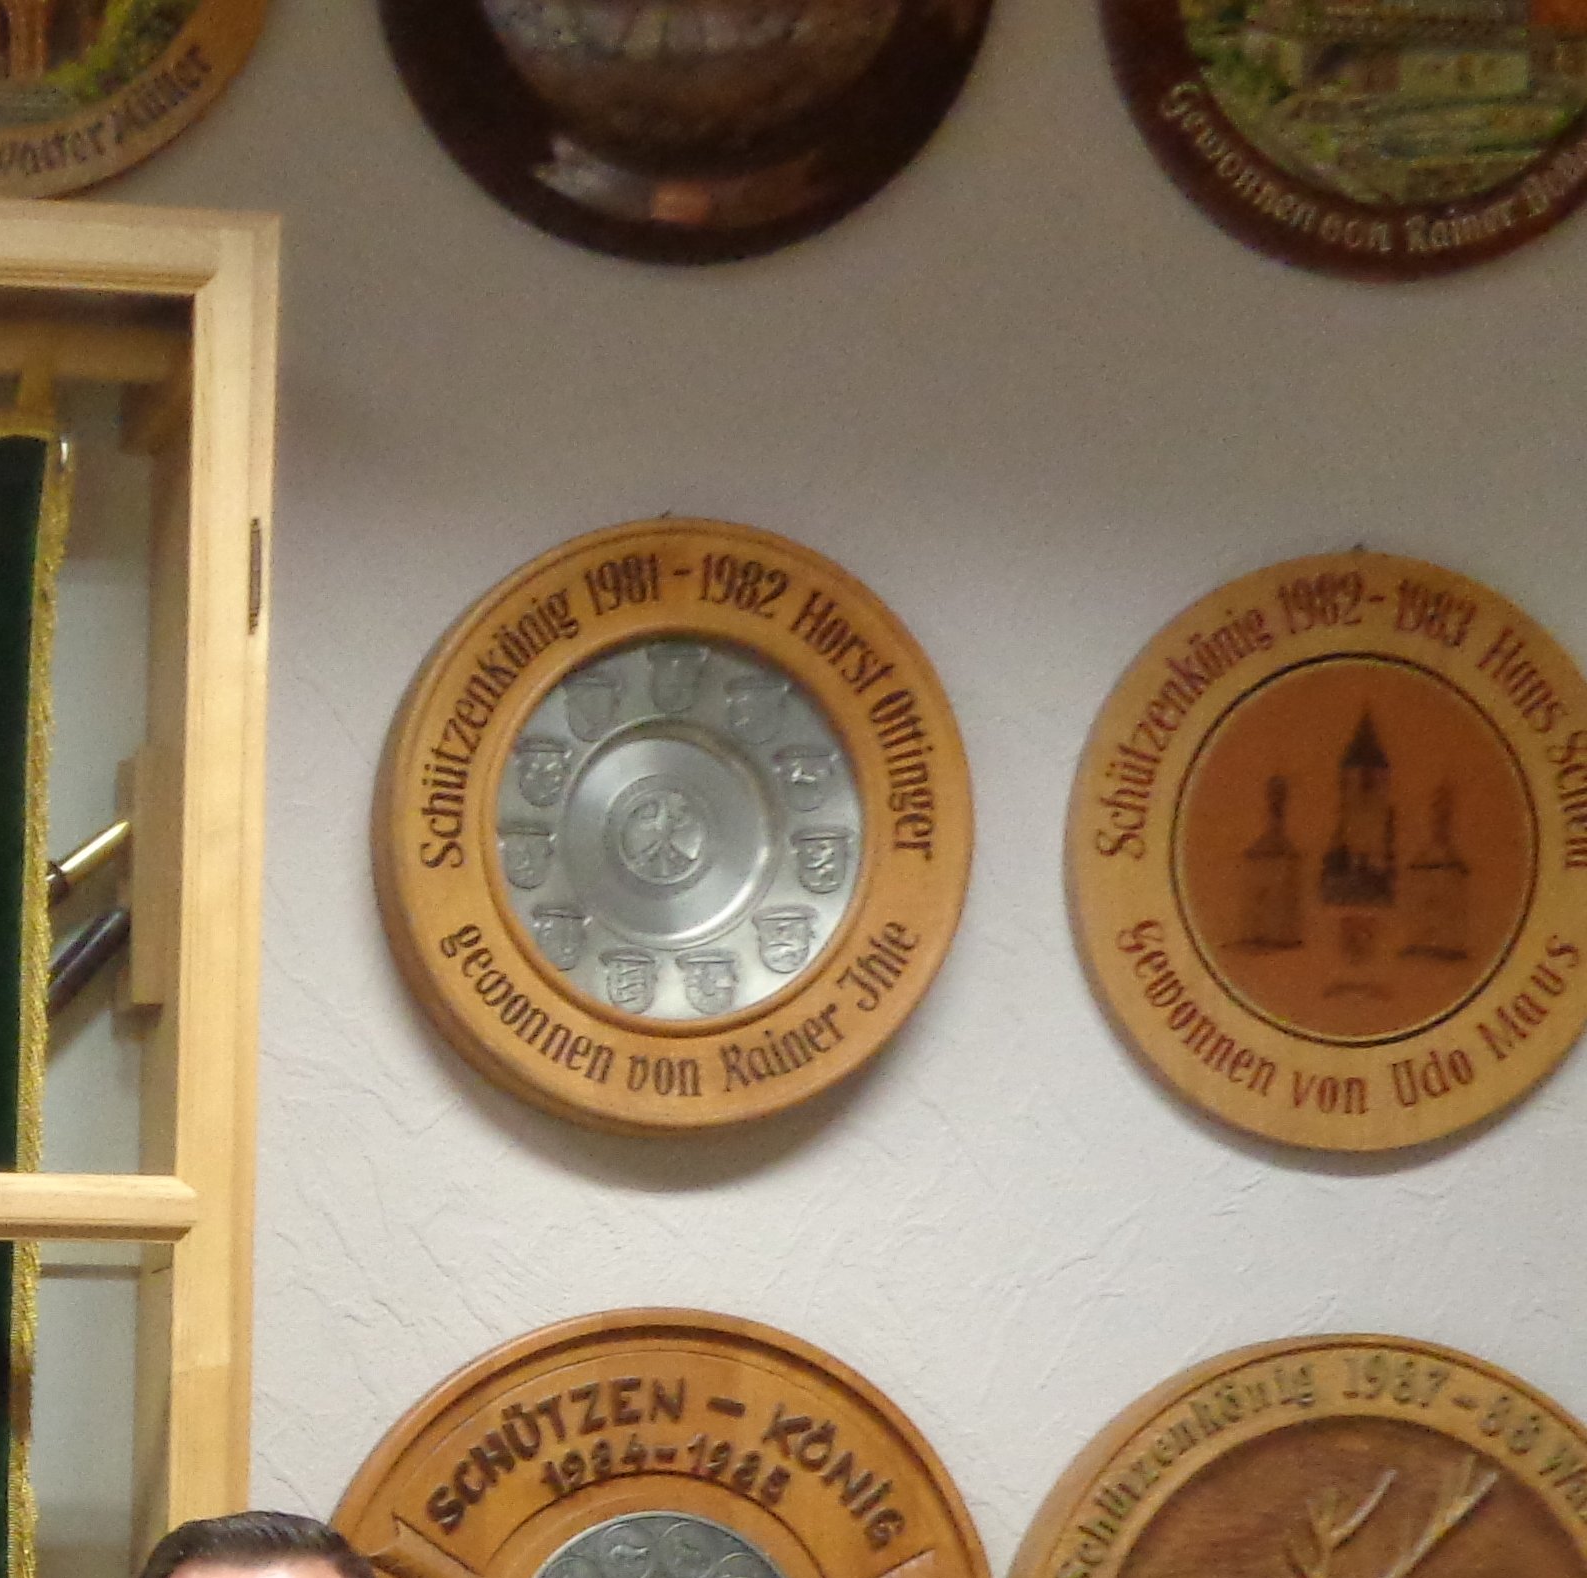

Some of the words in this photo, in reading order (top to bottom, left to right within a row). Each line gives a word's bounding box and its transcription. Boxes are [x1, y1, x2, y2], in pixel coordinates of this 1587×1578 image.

[419, 590, 581, 870] Schützenkönig
[583, 552, 663, 618] 1981
[702, 552, 790, 621] 1982
[788, 589, 897, 697] Horst
[627, 1050, 703, 1099] von
[719, 1002, 846, 1095] Rainer
[1292, 1068, 1368, 1115] von
[1391, 1049, 1475, 1109] Udo
[426, 1374, 688, 1535] SCHÜTZEN
